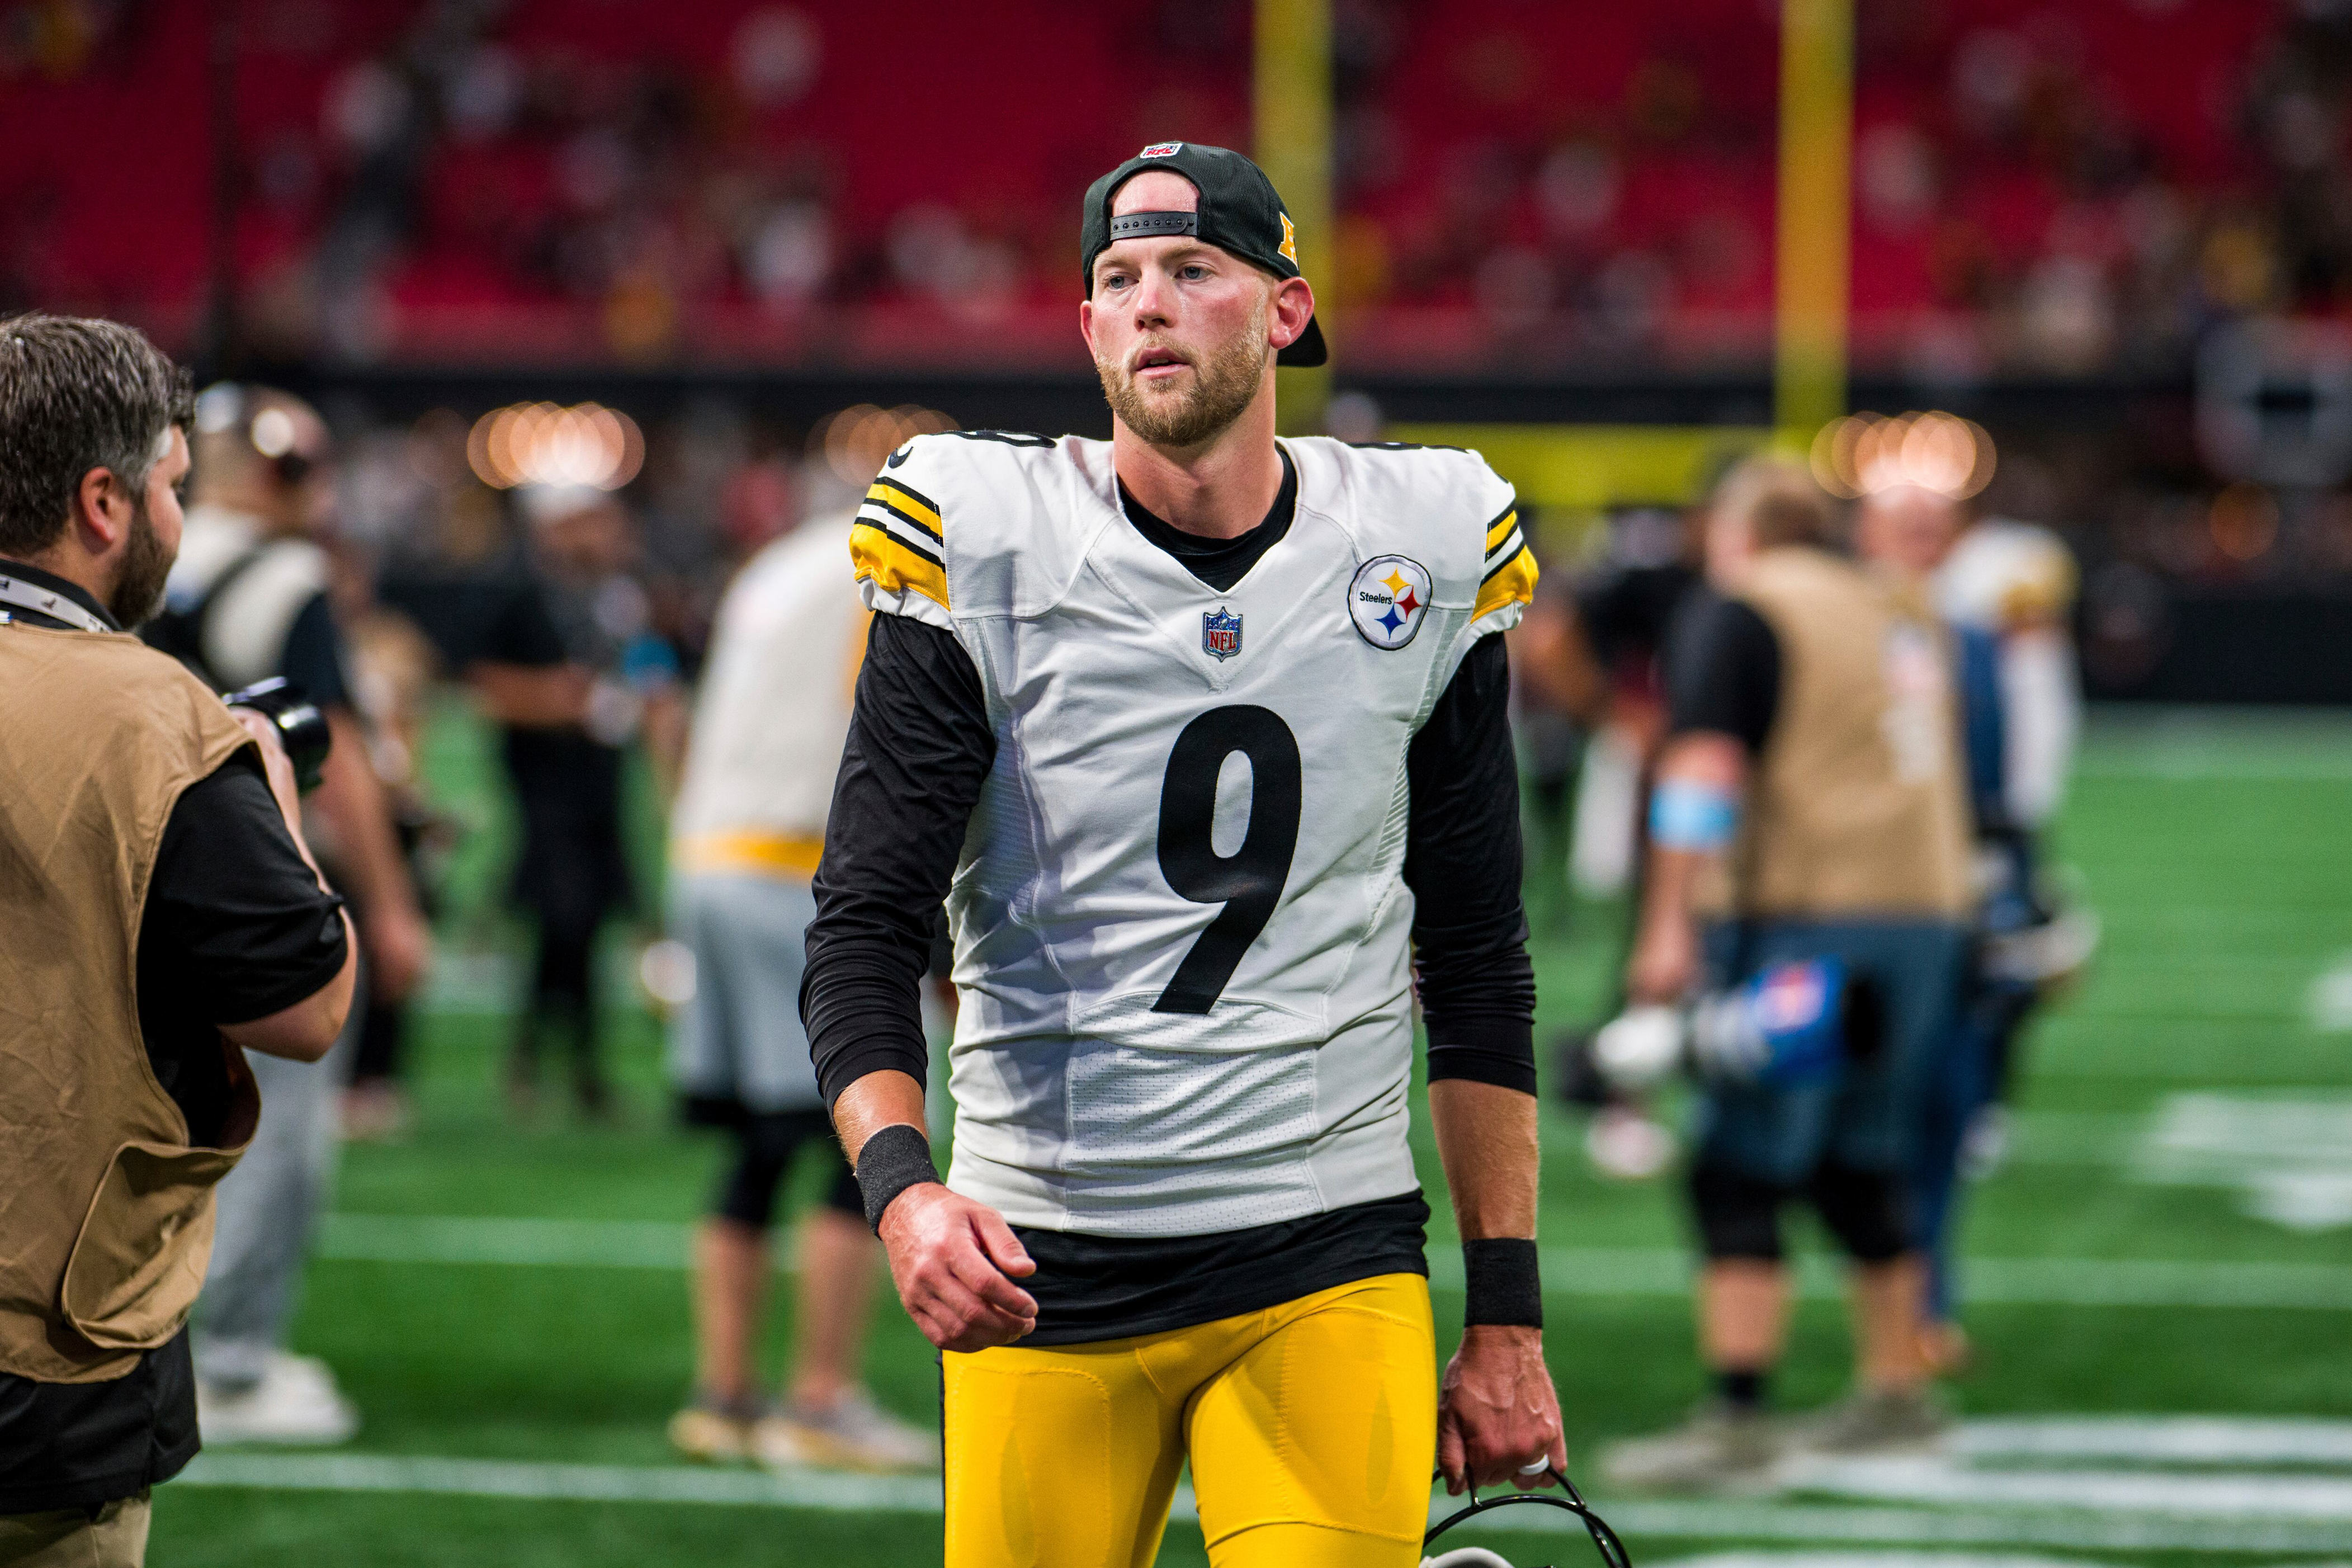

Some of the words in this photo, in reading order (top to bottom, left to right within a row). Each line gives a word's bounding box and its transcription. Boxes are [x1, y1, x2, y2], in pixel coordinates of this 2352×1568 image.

[1359, 592, 1392, 604] Steelers
[1209, 630, 1237, 651] NFL
[1150, 703, 1302, 1015] 9
